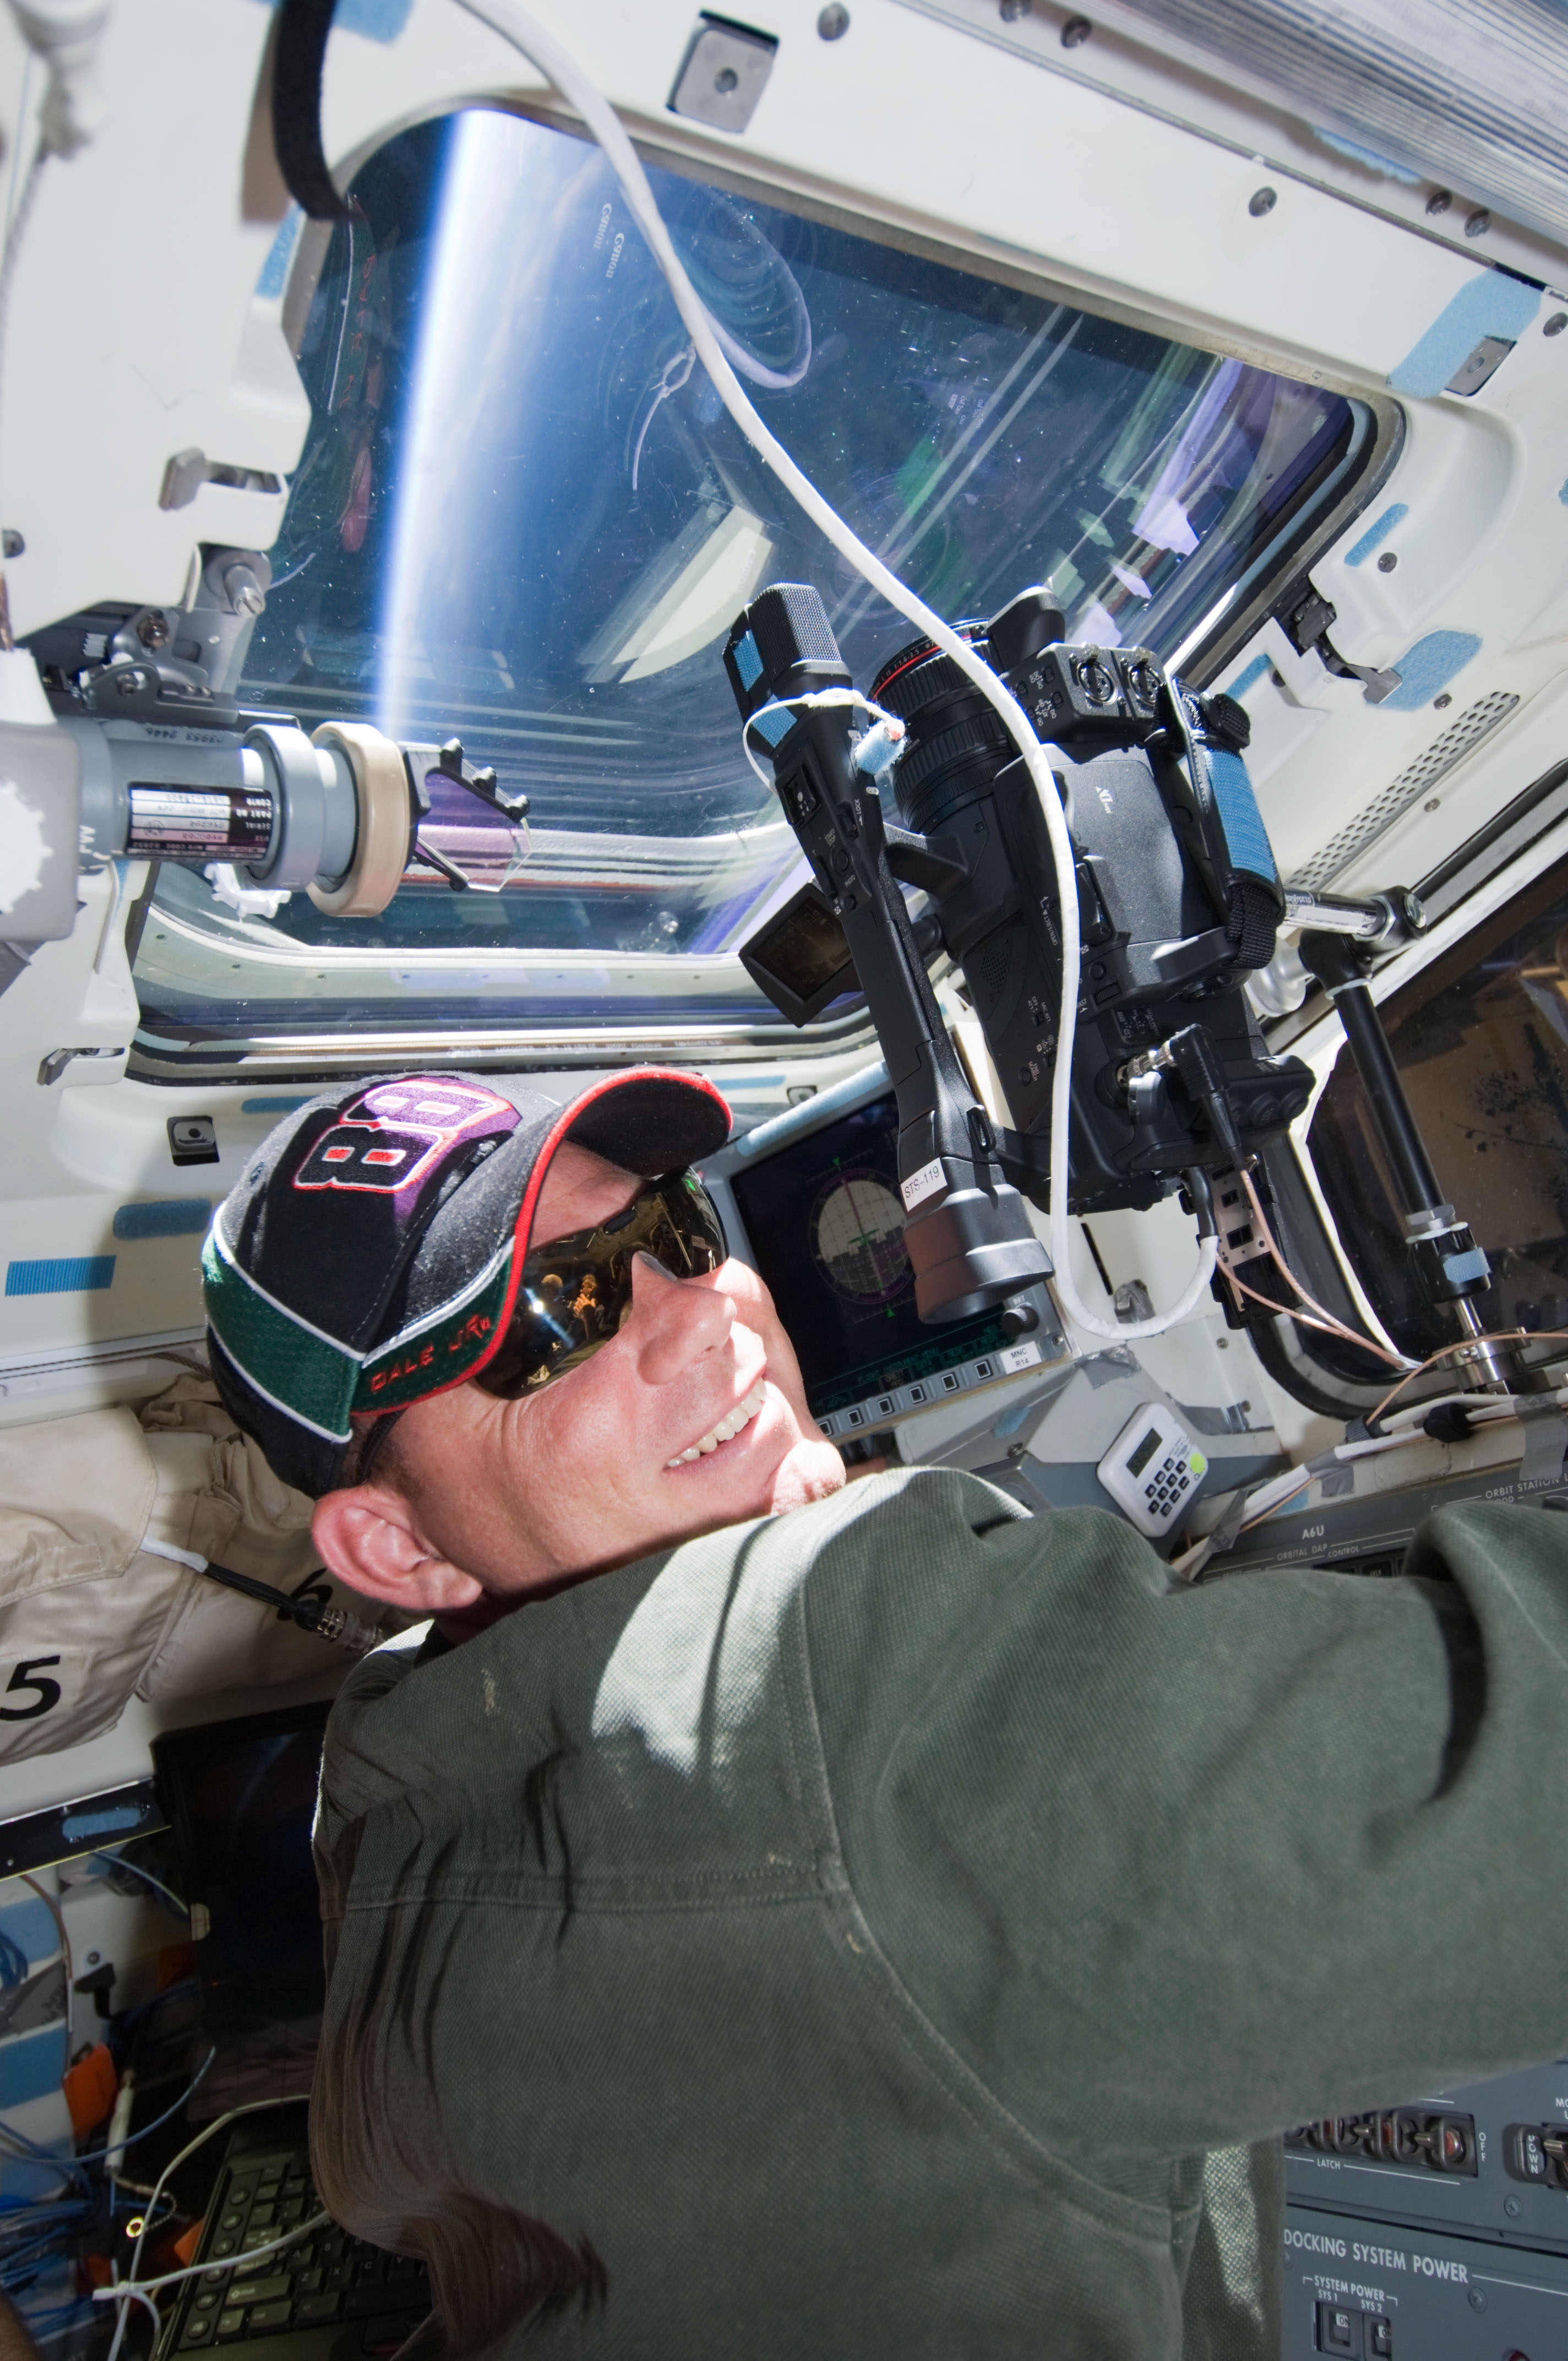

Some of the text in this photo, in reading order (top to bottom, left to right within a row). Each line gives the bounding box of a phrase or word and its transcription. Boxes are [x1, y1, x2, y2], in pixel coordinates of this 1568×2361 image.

[905, 1166, 939, 1199] STS-119
[1011, 1348, 1027, 1359] MNC
[371, 1345, 435, 1392] DALE
[1015, 1358, 1030, 1368] R14
[1485, 1478, 1560, 1499] ORBIT STATION
[1302, 1525, 1325, 1540] A6U
[1277, 1543, 1328, 1561] ORBITAL DAP
[1328, 1546, 1360, 1559] CONTROL
[0, 1655, 61, 1721] 5
[1317, 2158, 1341, 2170] LATCH
[1284, 2228, 1469, 2284] DOCKING SYSTEM POWER
[1314, 2275, 1385, 2302] SYSTEM POWER
[1318, 2289, 1338, 2302] SYS 1
[1361, 2299, 1383, 2313] SYS 2
